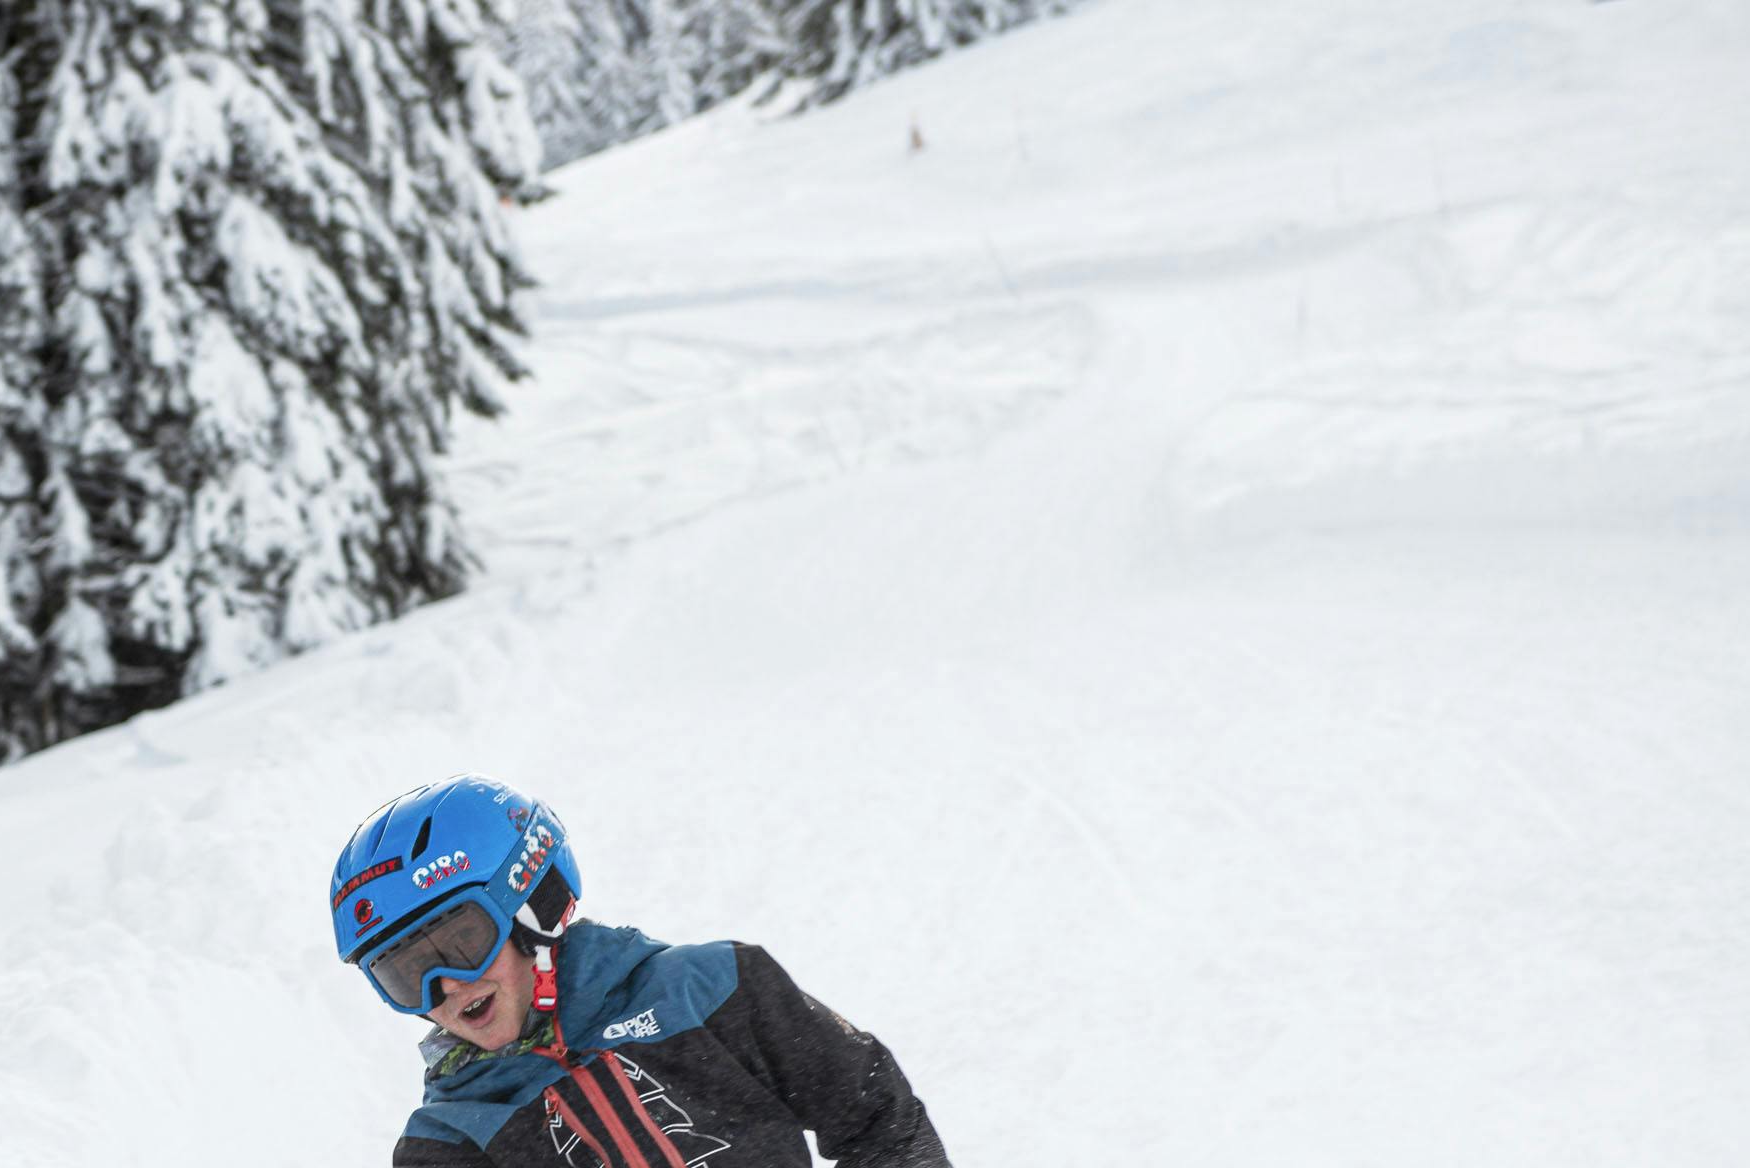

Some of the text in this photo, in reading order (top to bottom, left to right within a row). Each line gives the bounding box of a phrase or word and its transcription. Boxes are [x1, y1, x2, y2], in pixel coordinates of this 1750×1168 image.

[412, 850, 470, 889] GIRO
[508, 825, 554, 892] GIRO
[334, 860, 396, 909] MAMMUT
